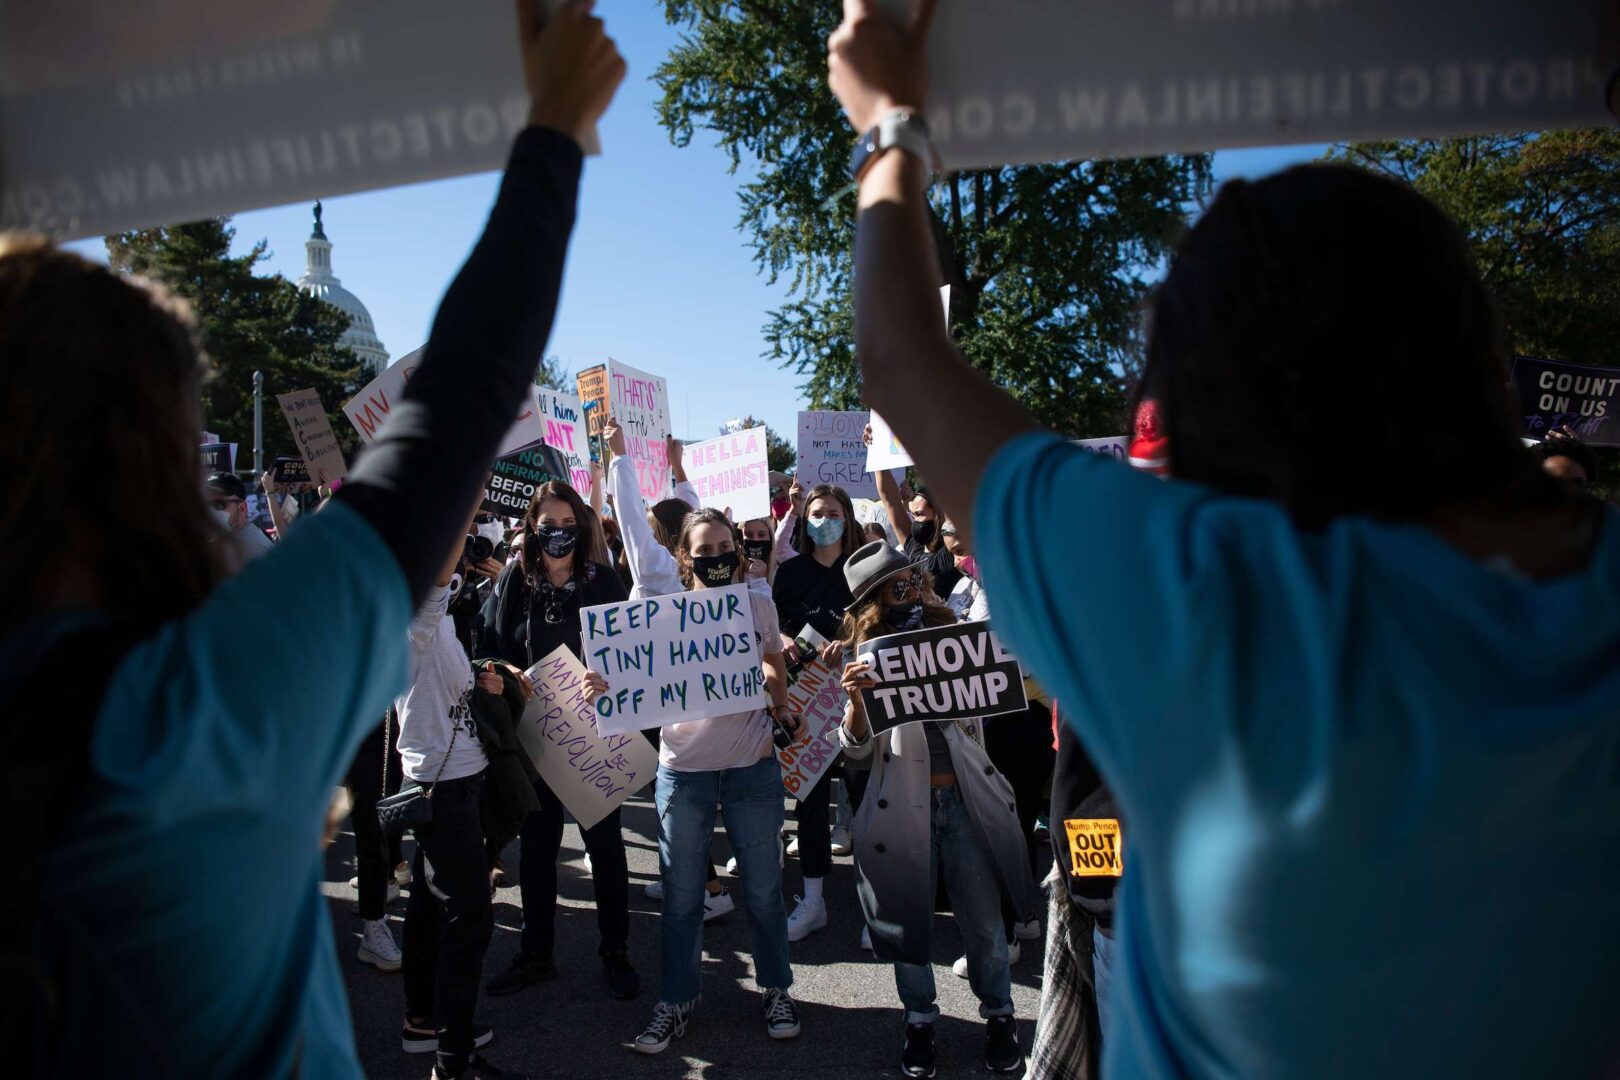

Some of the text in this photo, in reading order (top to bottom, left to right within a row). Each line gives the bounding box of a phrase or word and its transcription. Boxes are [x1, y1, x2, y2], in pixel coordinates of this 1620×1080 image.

[583, 386, 605, 400] Pence
[612, 373, 656, 411] THAT'S
[1538, 370, 1620, 397] COUNT
[553, 396, 577, 422] him
[1538, 393, 1608, 417] ON US
[627, 411, 648, 436] the
[813, 411, 869, 439] LOV
[692, 435, 759, 468] HELLA
[812, 440, 830, 449] NOT
[823, 450, 853, 459] MAKES
[518, 450, 544, 467] NO
[490, 475, 535, 497] BEFO
[818, 461, 873, 484] GREA
[587, 593, 745, 641] KEEP YOUR
[593, 632, 751, 678] TINY HANDS
[596, 687, 645, 718] OFF
[660, 679, 688, 712] MY
[873, 671, 1009, 720] TRUMP
[540, 656, 582, 692] MAY
[611, 753, 630, 772] BE
[625, 771, 637, 784] A
[536, 707, 625, 799] REVOLUTION
[784, 765, 809, 793] BY
[1075, 833, 1115, 850] OUT
